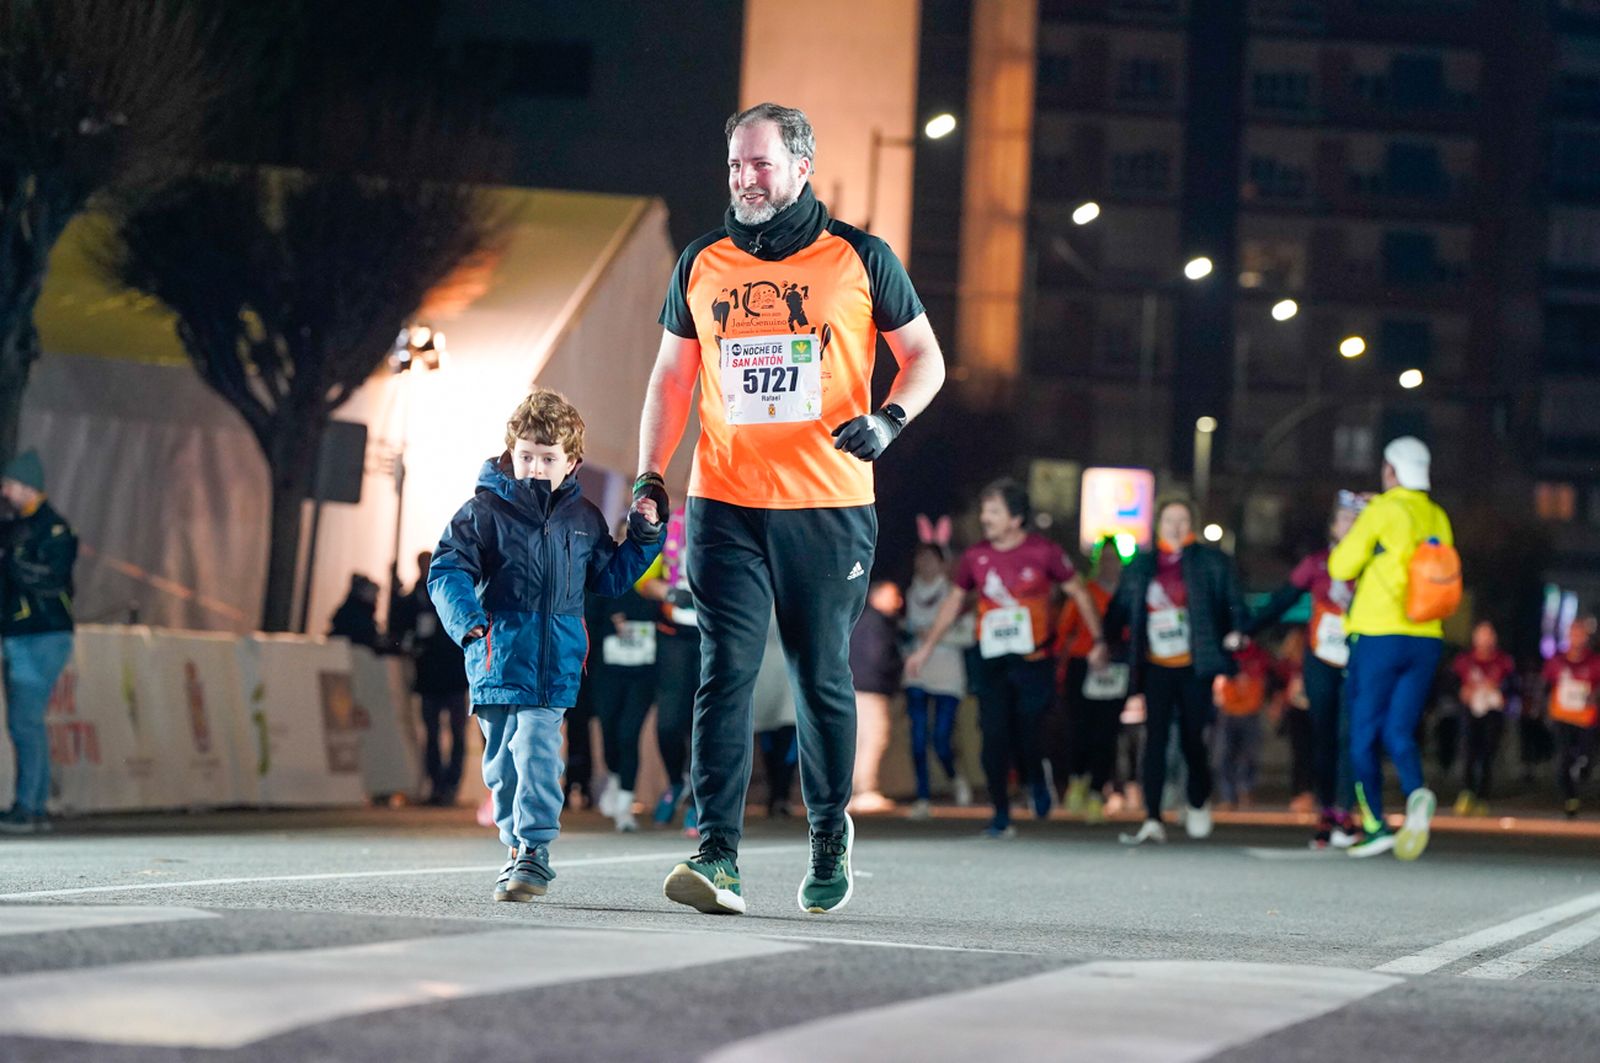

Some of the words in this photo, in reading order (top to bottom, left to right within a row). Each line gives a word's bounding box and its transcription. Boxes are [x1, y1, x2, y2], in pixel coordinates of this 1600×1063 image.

[743, 346, 770, 356] NOCHE
[772, 345, 783, 354] DE
[732, 358, 750, 368] SAN
[752, 354, 784, 366] ANTÓN
[743, 366, 799, 394] 5727
